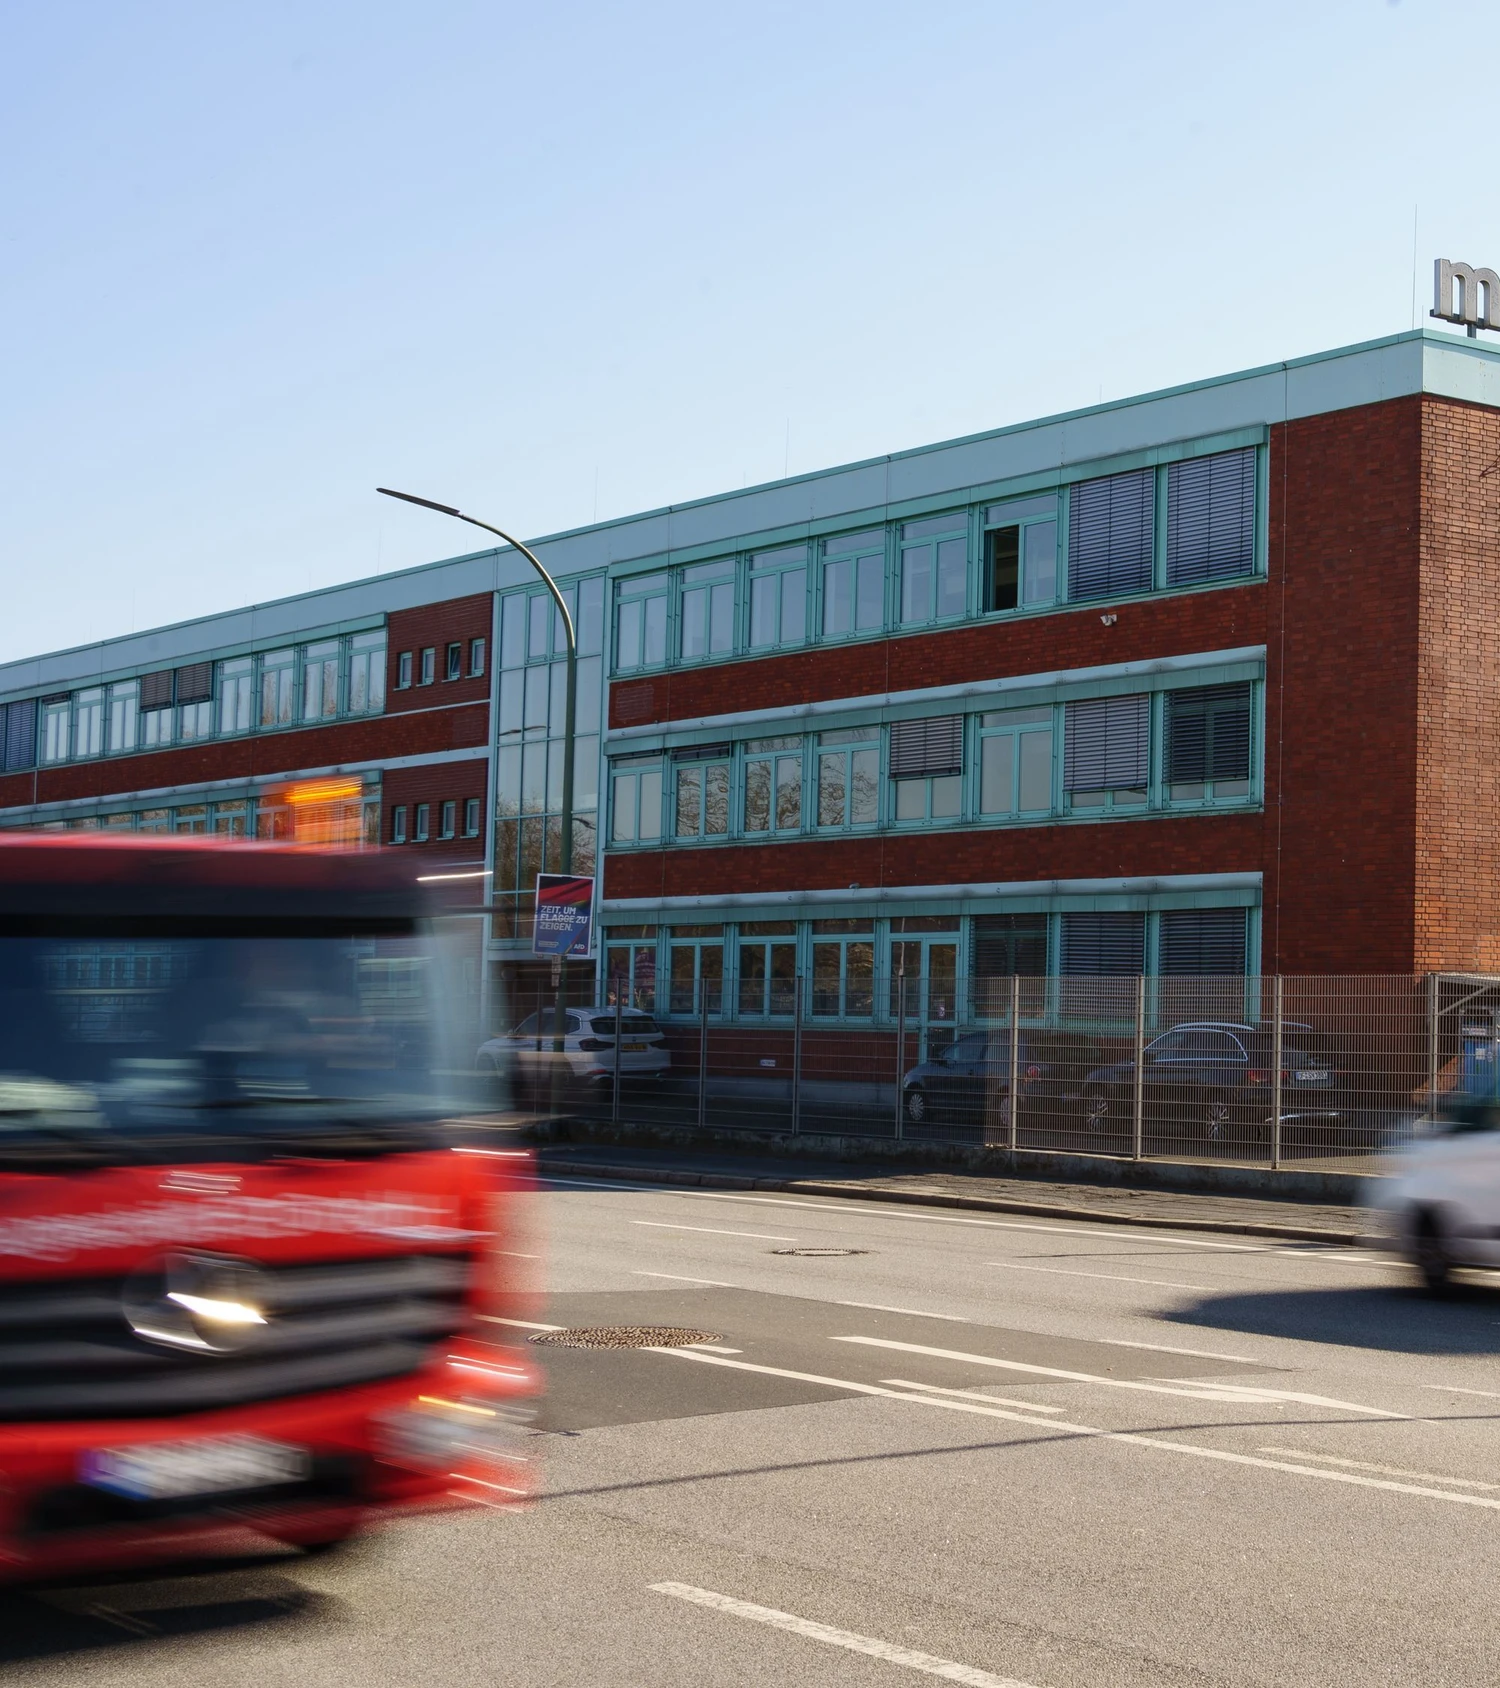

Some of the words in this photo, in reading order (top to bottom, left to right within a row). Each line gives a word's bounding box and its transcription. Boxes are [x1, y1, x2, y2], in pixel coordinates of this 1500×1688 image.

[541, 906, 561, 914] ZEIT,
[563, 906, 576, 915] UM
[540, 914, 575, 923] FLAGGE
[576, 916, 588, 924] ZU
[540, 921, 573, 931] ZEIGEN.
